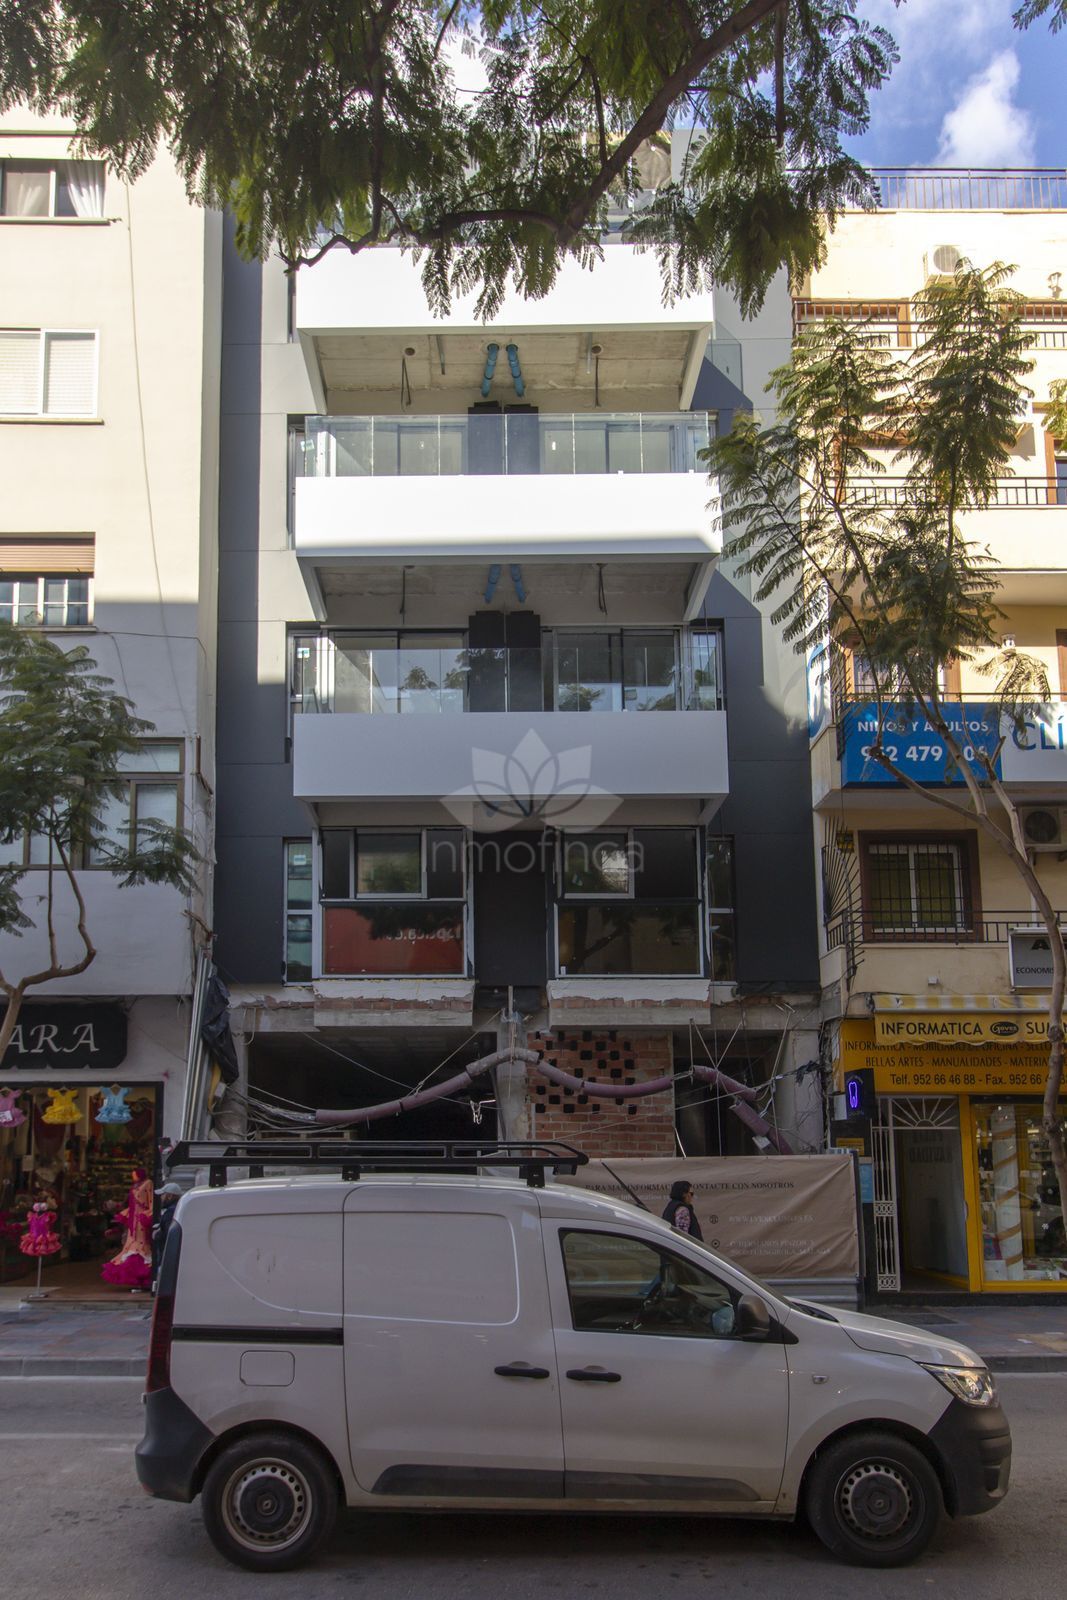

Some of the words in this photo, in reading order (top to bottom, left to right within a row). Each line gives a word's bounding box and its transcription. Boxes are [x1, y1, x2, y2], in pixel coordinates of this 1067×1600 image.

[911, 721, 919, 732] Y
[923, 721, 989, 732] AULTOS
[905, 745, 943, 762] 479
[881, 1022, 984, 1035] INFORMATICA
[865, 1056, 896, 1068] BELLAS
[897, 1056, 925, 1068] ARTES
[932, 1056, 1002, 1068] MANUALIDADES
[889, 1073, 911, 1085] Telf.
[913, 1073, 932, 1085] 952
[934, 1073, 947, 1085] 66
[949, 1073, 961, 1085] 46
[963, 1073, 976, 1085] 88
[985, 1073, 1007, 1086] Fax.
[1008, 1073, 1027, 1085] 952
[1029, 1073, 1042, 1085] 66
[731, 1182, 749, 1190] CON
[751, 1181, 795, 1190] NOSOTROS
